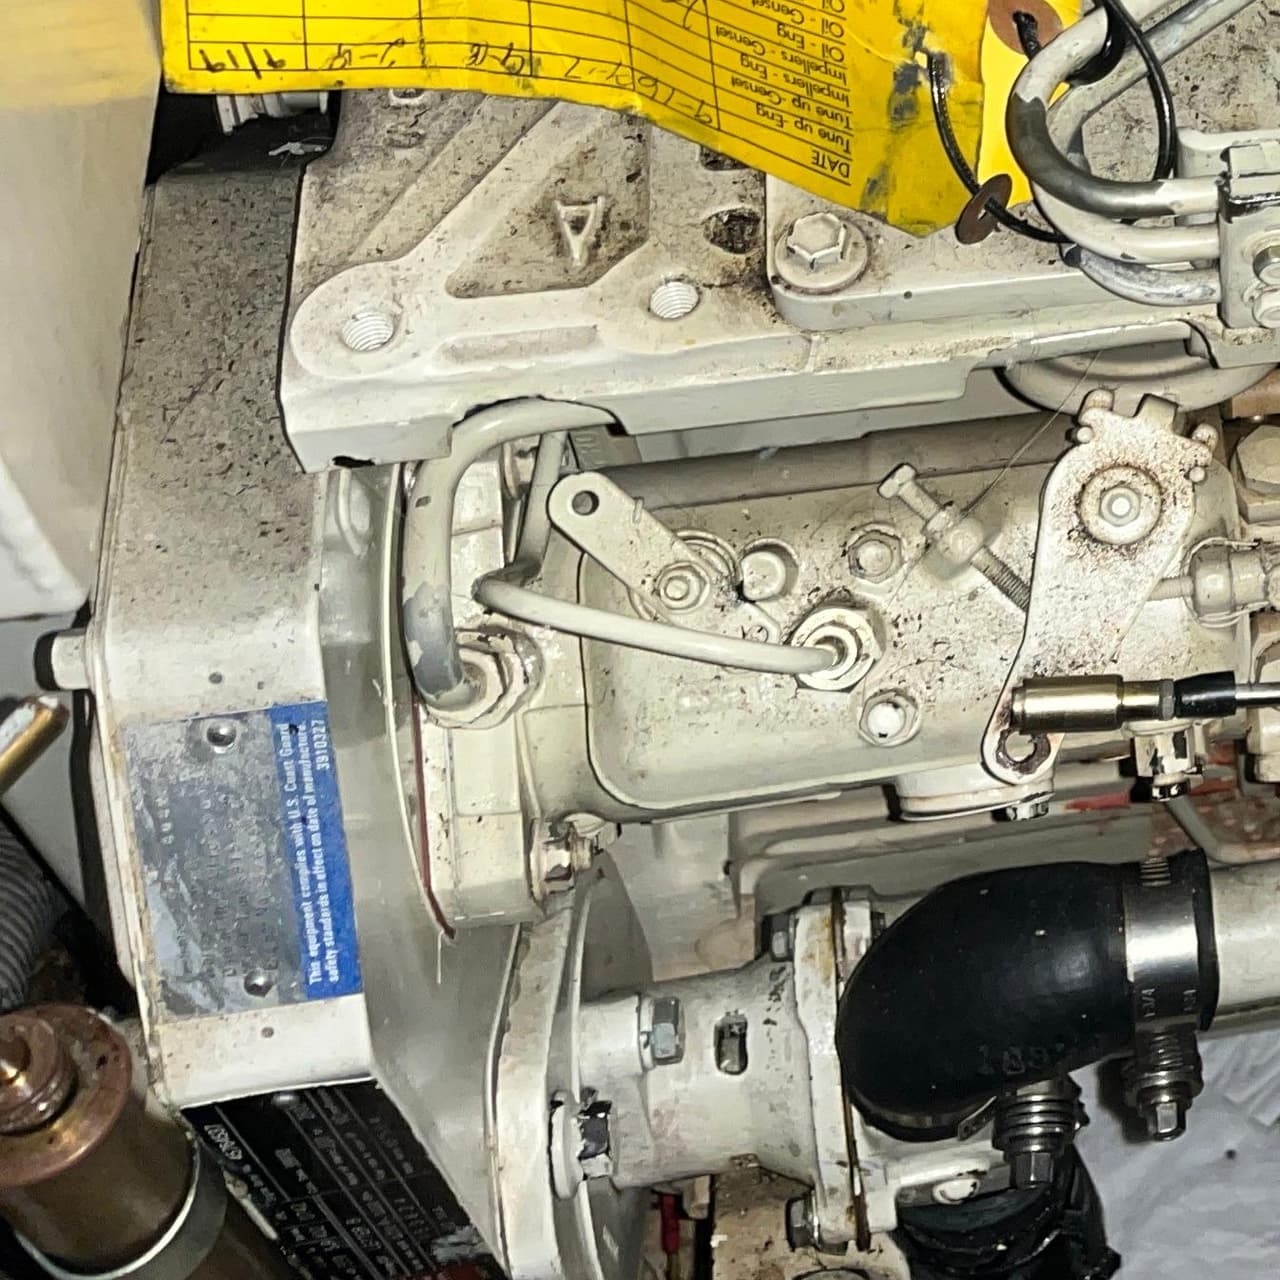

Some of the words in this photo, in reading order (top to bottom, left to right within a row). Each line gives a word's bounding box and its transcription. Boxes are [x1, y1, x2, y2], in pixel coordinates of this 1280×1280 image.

[714, 25, 765, 54] Genset
[776, 22, 804, 47] Eng
[821, 18, 842, 38] Oil
[197, 41, 285, 80] 9/19
[740, 53, 766, 77] Eng
[821, 43, 842, 63] Oil
[782, 50, 845, 85] Impellers
[730, 75, 786, 106] -Genset
[784, 72, 848, 107] Impellers
[754, 102, 789, 128] -Eng
[792, 94, 810, 114] up
[816, 105, 849, 129] Tune
[794, 115, 813, 136] up
[818, 127, 851, 153] Tune
[810, 148, 850, 178] DATE
[555, 196, 604, 265] A
[276, 722, 293, 756] Guard
[311, 719, 330, 770] 3910327
[293, 720, 314, 793] manufacture.
[280, 760, 297, 791] Coast
[286, 795, 301, 818] U.S.
[302, 794, 316, 805] of
[305, 807, 320, 831] date
[290, 822, 305, 846] with
[311, 832, 322, 846] on
[294, 849, 313, 898] complies
[310, 848, 326, 879] effect
[315, 882, 328, 892] in
[302, 900, 321, 957] equipment
[316, 894, 334, 946] standards
[306, 961, 322, 984] This
[323, 948, 339, 982] safety
